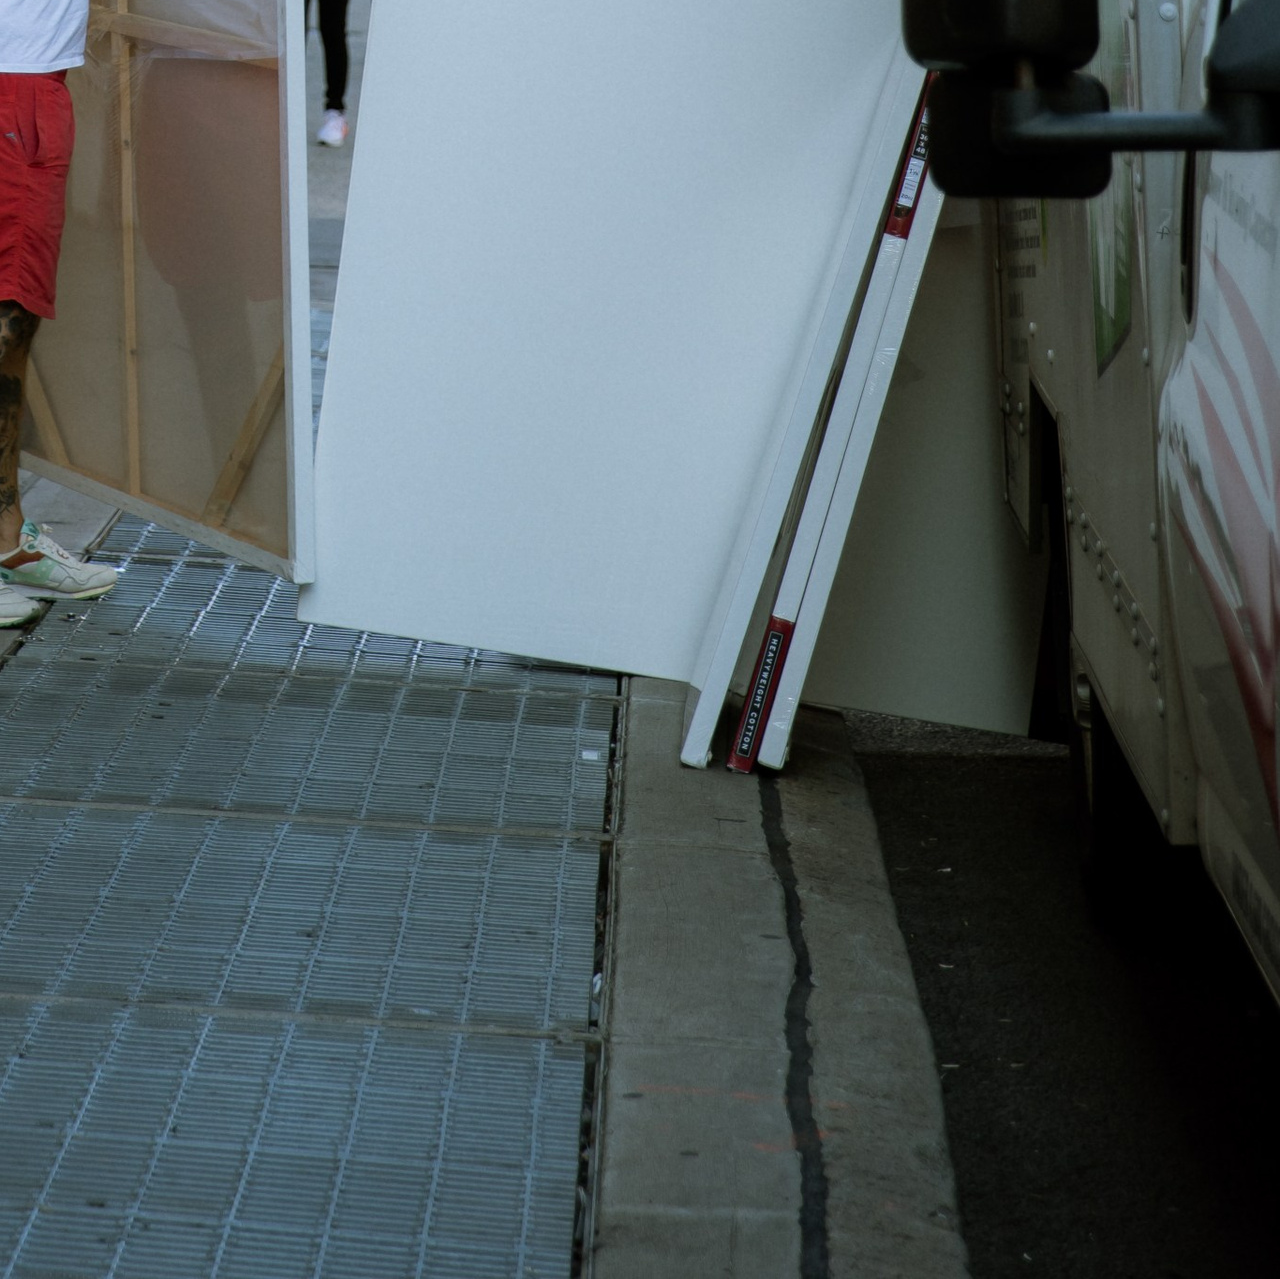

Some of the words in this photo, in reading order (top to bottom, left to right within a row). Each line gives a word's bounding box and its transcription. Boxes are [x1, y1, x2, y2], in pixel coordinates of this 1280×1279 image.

[915, 146, 925, 154] 48
[753, 638, 778, 708] HEAVYWEIGHT
[741, 711, 758, 751] COTTON
